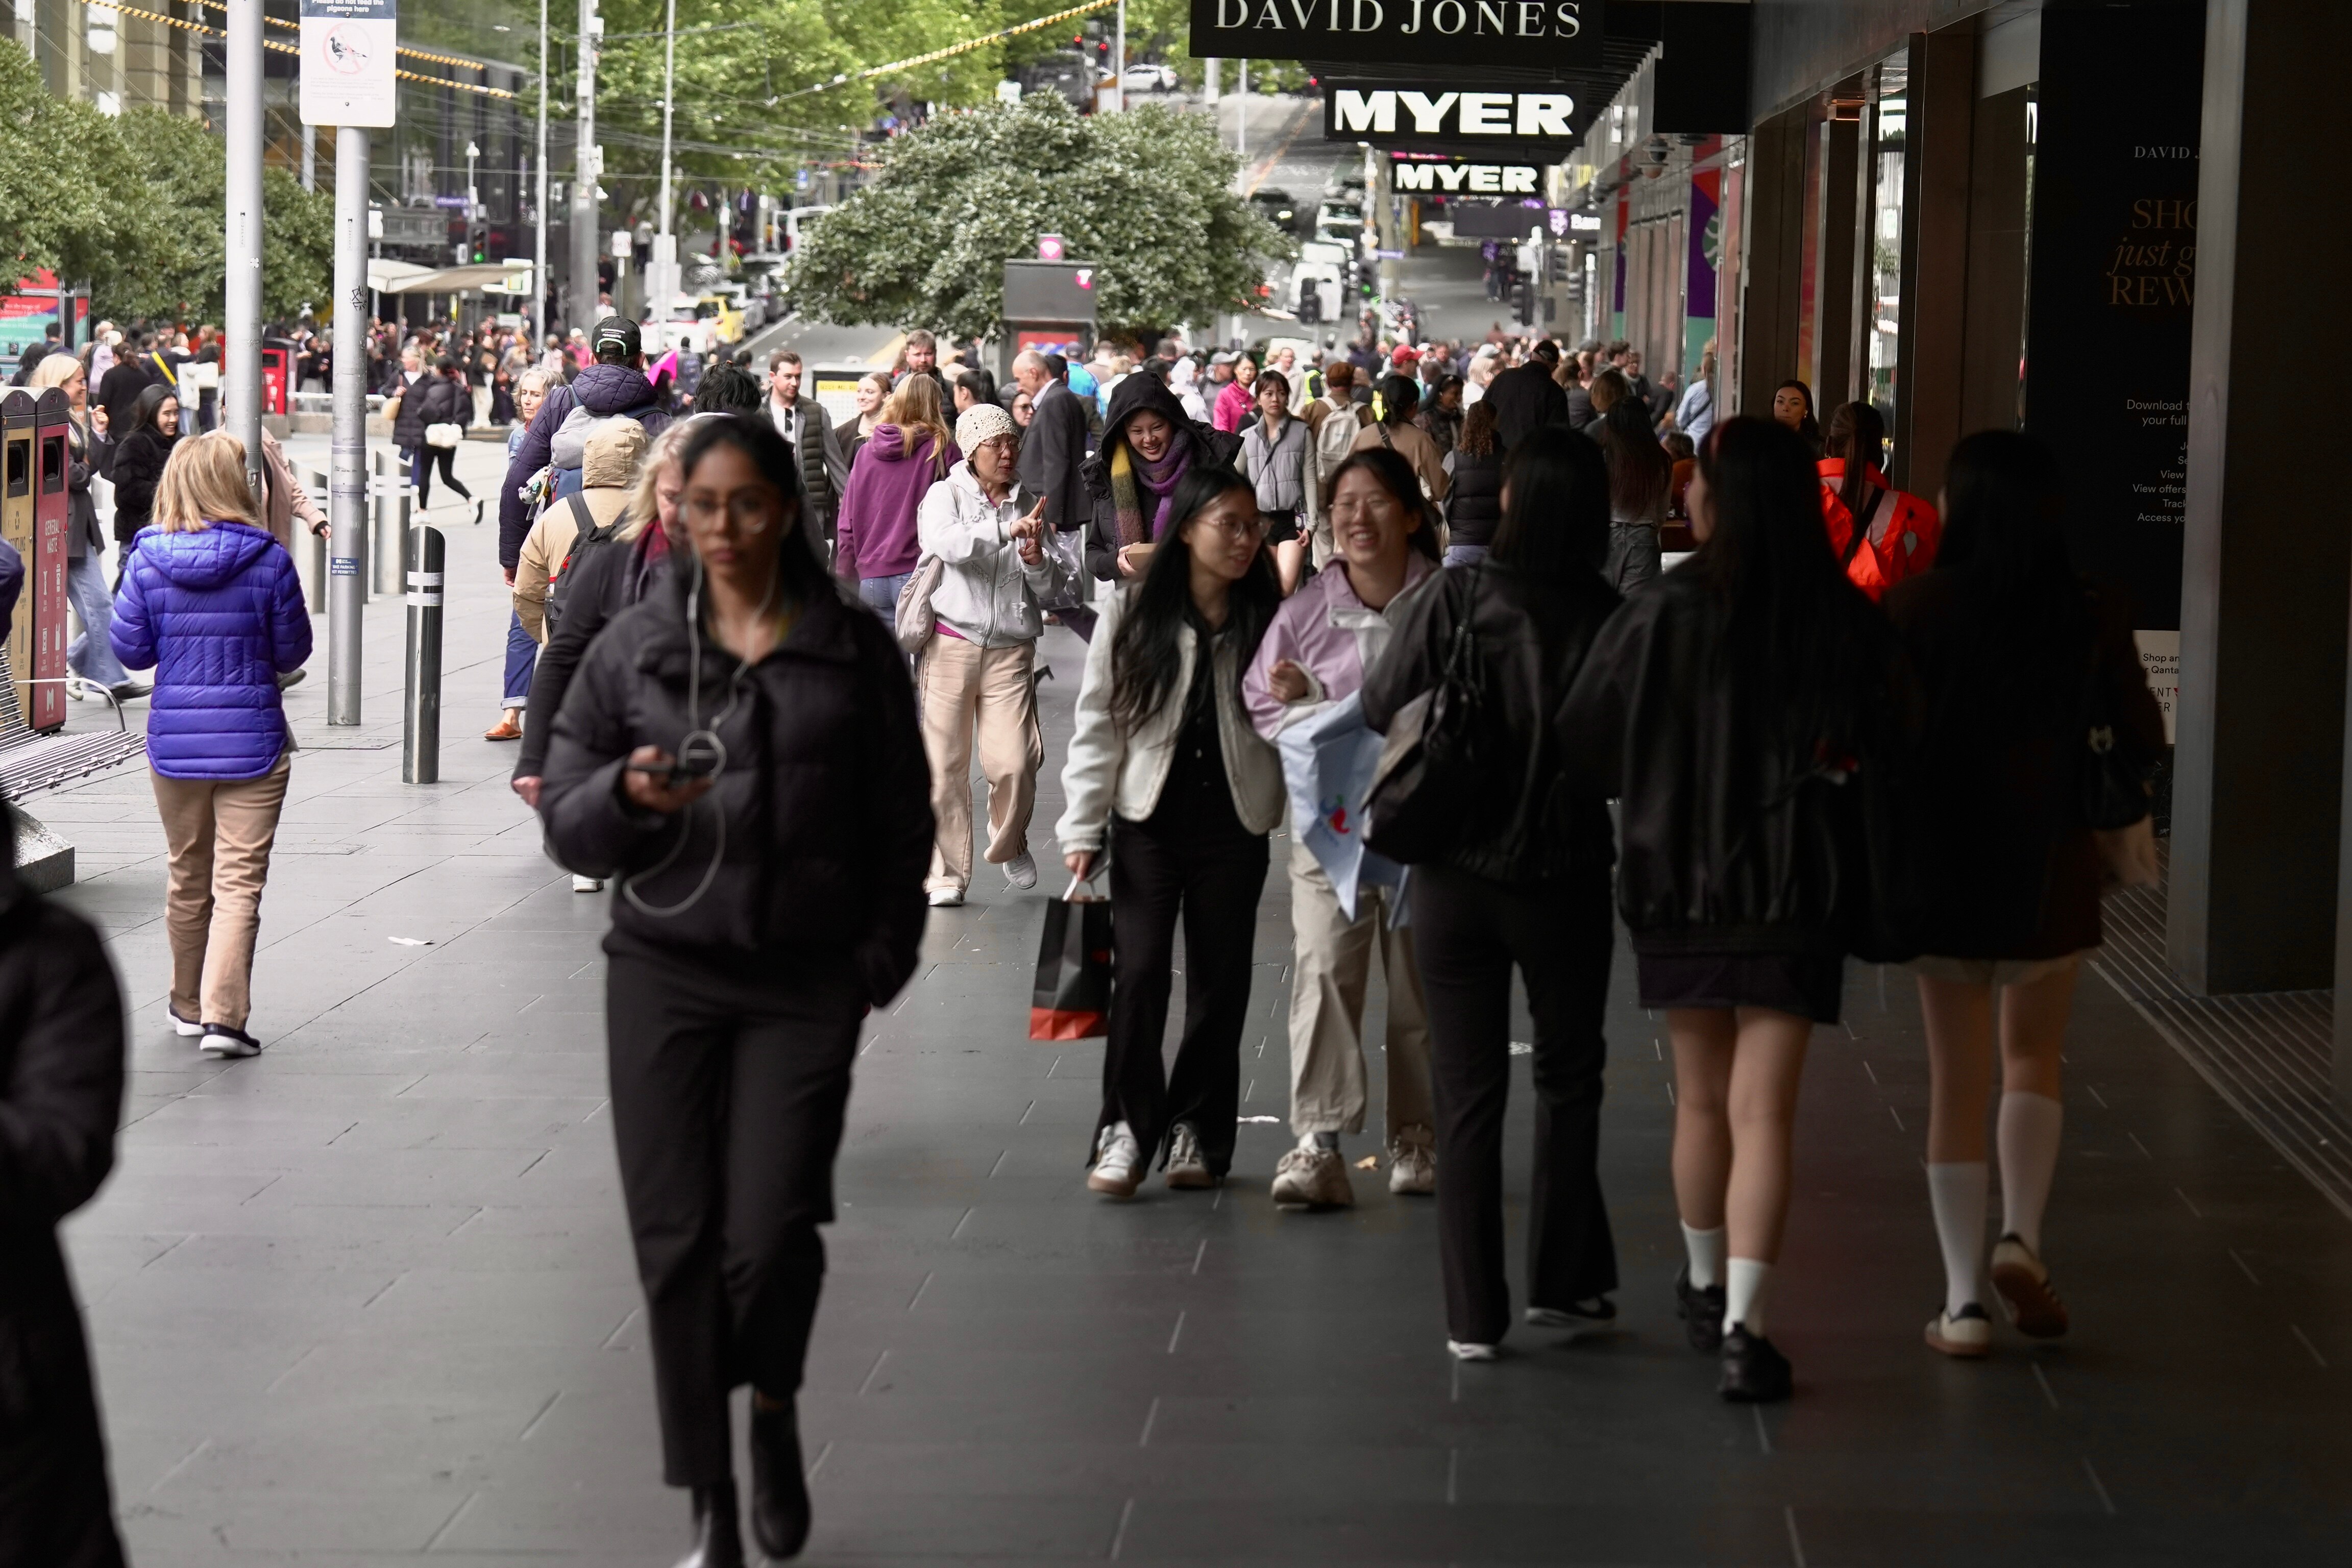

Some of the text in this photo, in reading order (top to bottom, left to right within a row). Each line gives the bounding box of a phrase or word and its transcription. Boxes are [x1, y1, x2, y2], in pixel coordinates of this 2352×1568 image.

[1214, 0, 1581, 38] DAVID JONES
[1335, 90, 1574, 135] MYER
[2134, 146, 2190, 159] DAVID
[1396, 163, 1537, 192] MYER
[2106, 237, 2172, 276] just
[2127, 399, 2183, 410] Download
[2142, 415, 2186, 427] your full
[2160, 470, 2185, 479] View
[2133, 483, 2186, 493] View offers
[2137, 512, 2171, 522] Access
[2143, 653, 2167, 663] Shop
[2151, 666, 2179, 674] Qanta
